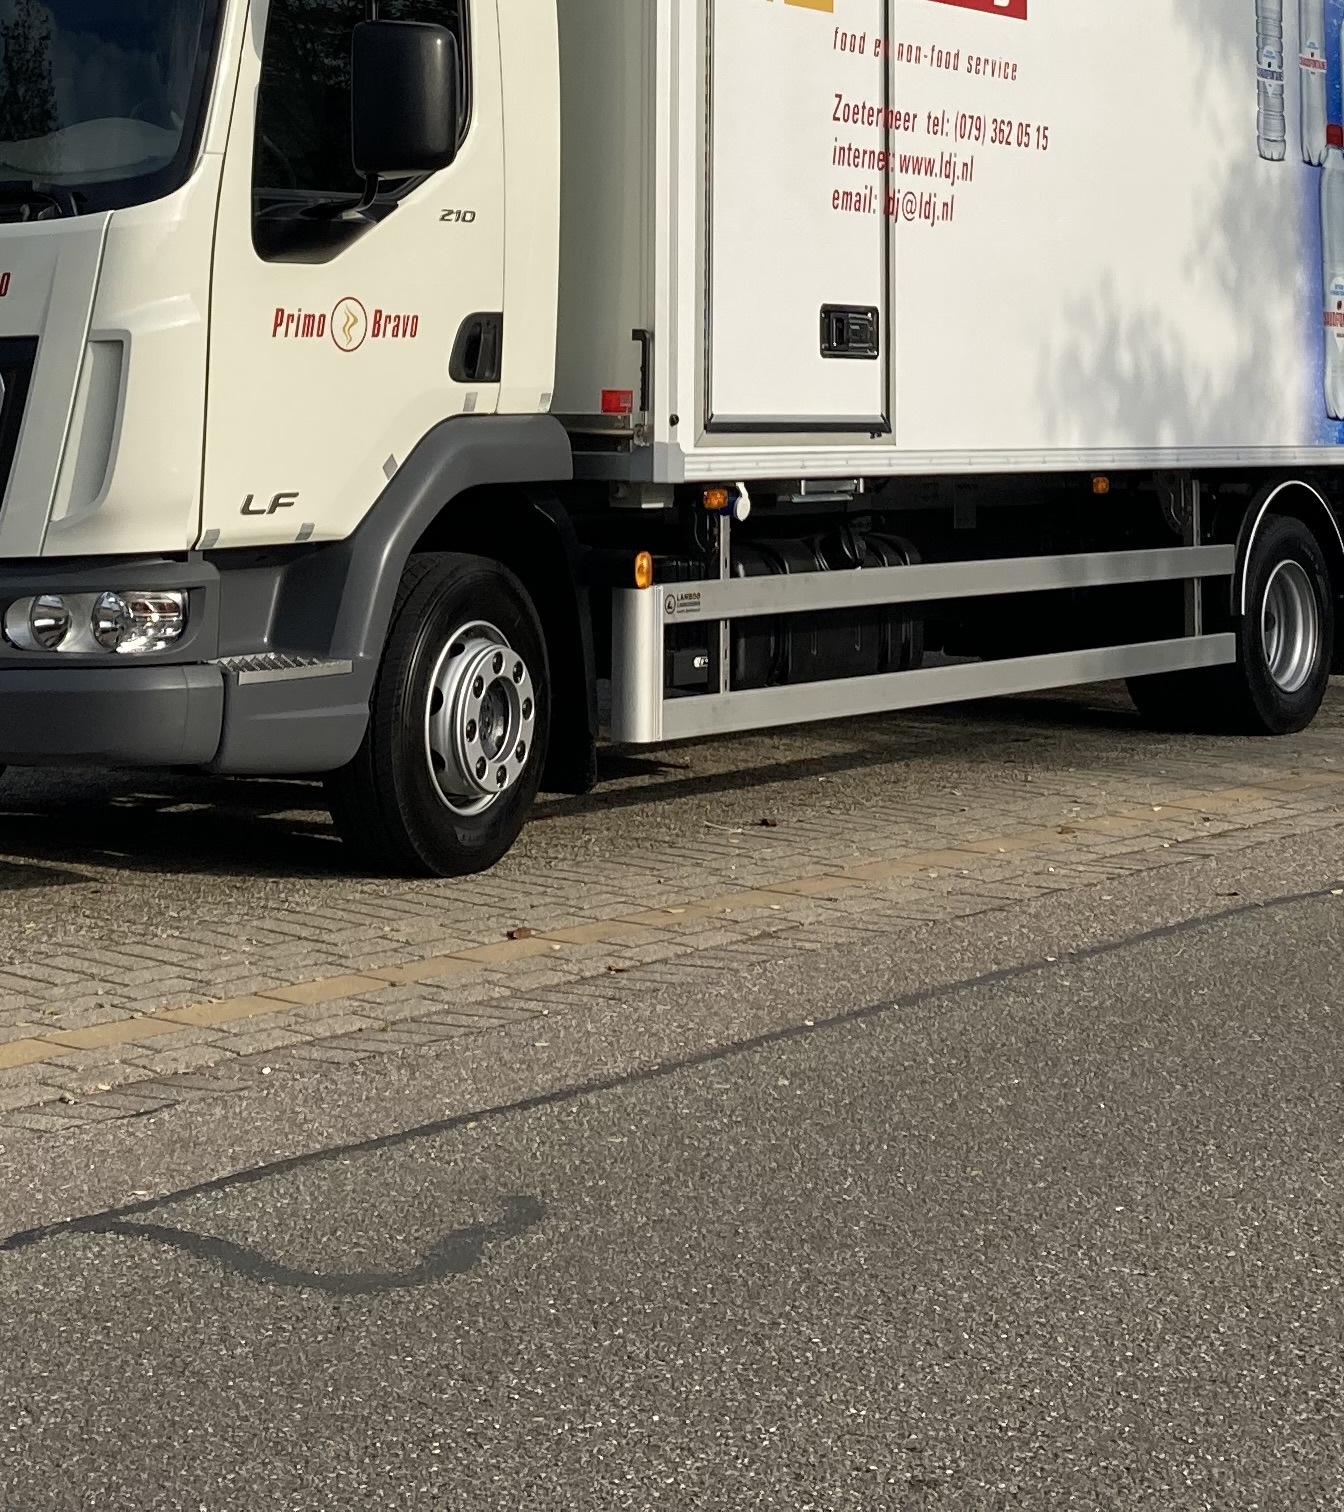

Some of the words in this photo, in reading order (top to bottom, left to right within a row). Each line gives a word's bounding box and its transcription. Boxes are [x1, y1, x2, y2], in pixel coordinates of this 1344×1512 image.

[833, 27, 866, 55] food
[897, 42, 960, 72] non-food
[966, 54, 1018, 81] service
[926, 109, 950, 137] tel:
[954, 110, 987, 146] (079)
[990, 118, 1012, 146] 362
[1016, 122, 1031, 148] 05
[1035, 125, 1049, 151] 15
[899, 151, 974, 186] www.ldj.nl
[831, 184, 878, 214] email:
[439, 209, 476, 223] 210
[272, 308, 326, 338] Primo
[371, 309, 419, 338] Bravo
[240, 491, 300, 516] LF
